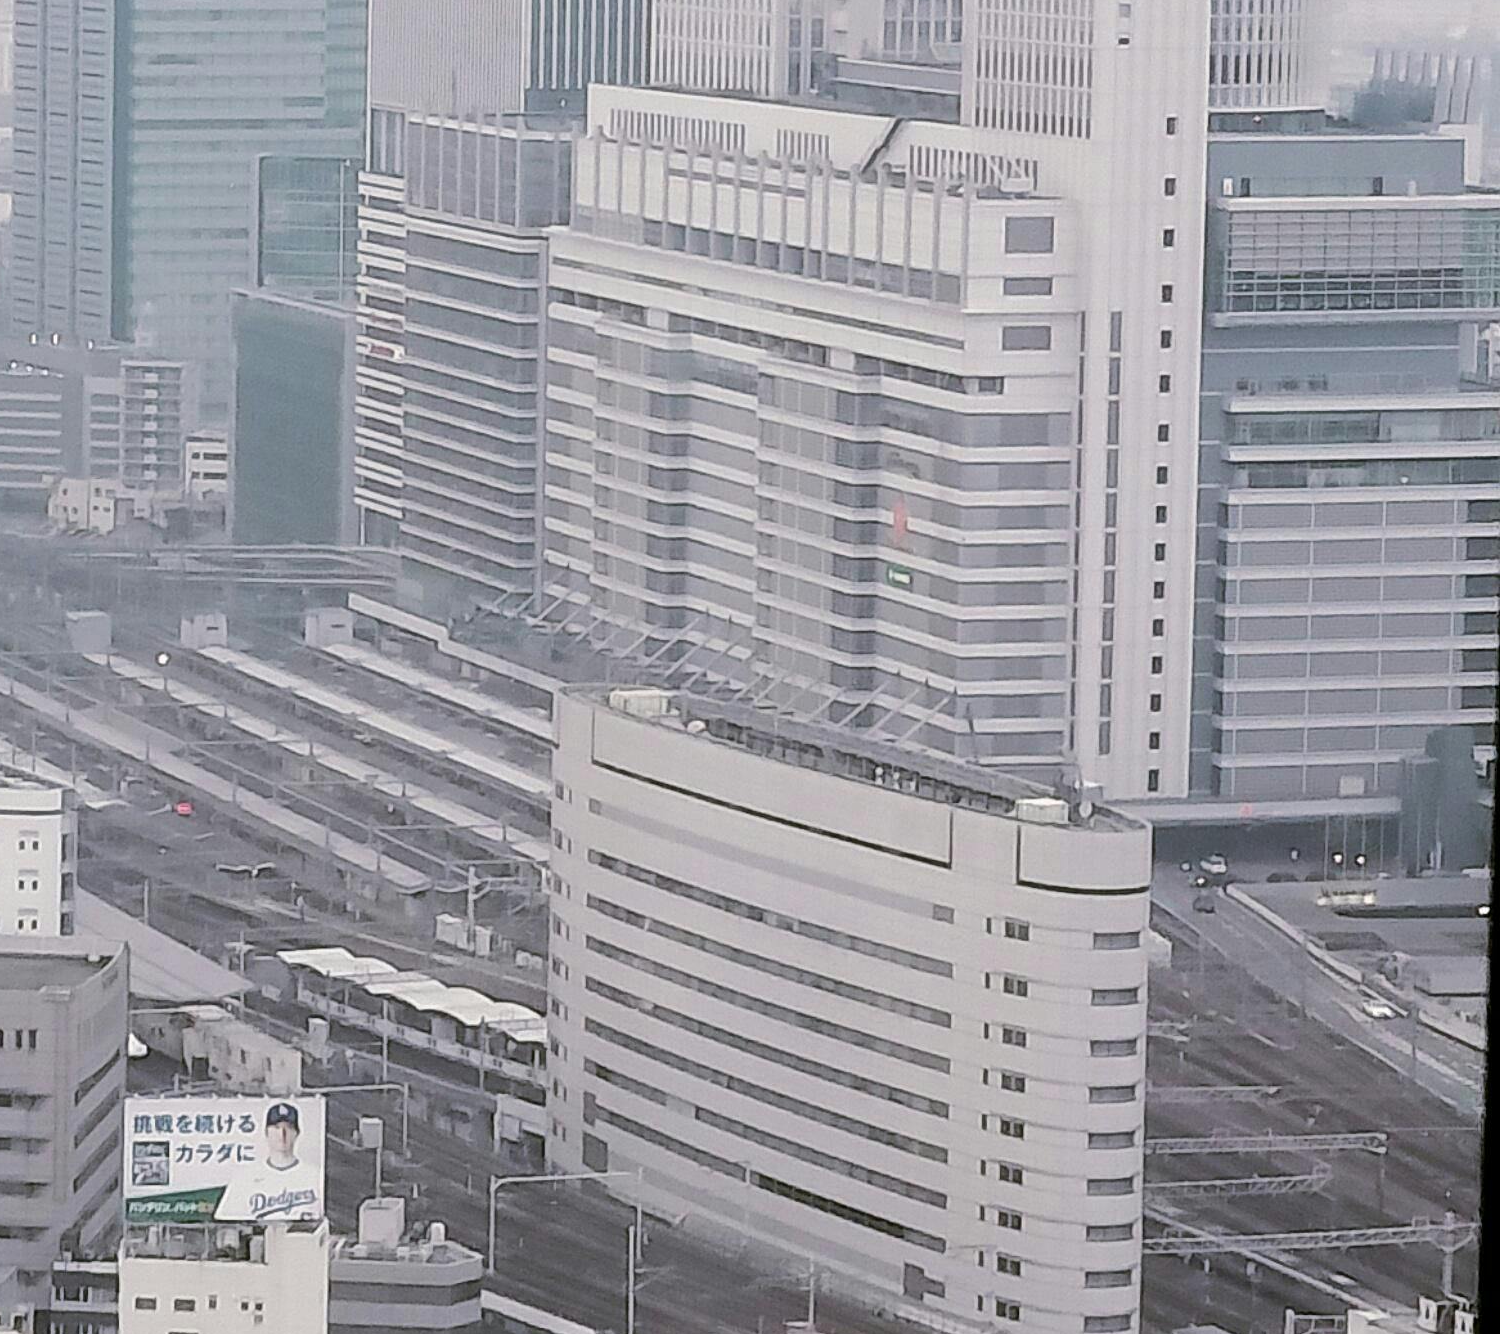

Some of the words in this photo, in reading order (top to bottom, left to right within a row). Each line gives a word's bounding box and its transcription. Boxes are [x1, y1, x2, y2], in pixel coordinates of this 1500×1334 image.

[133, 1114, 255, 1134] 挑戦を続ける
[175, 1143, 255, 1163] カラダに
